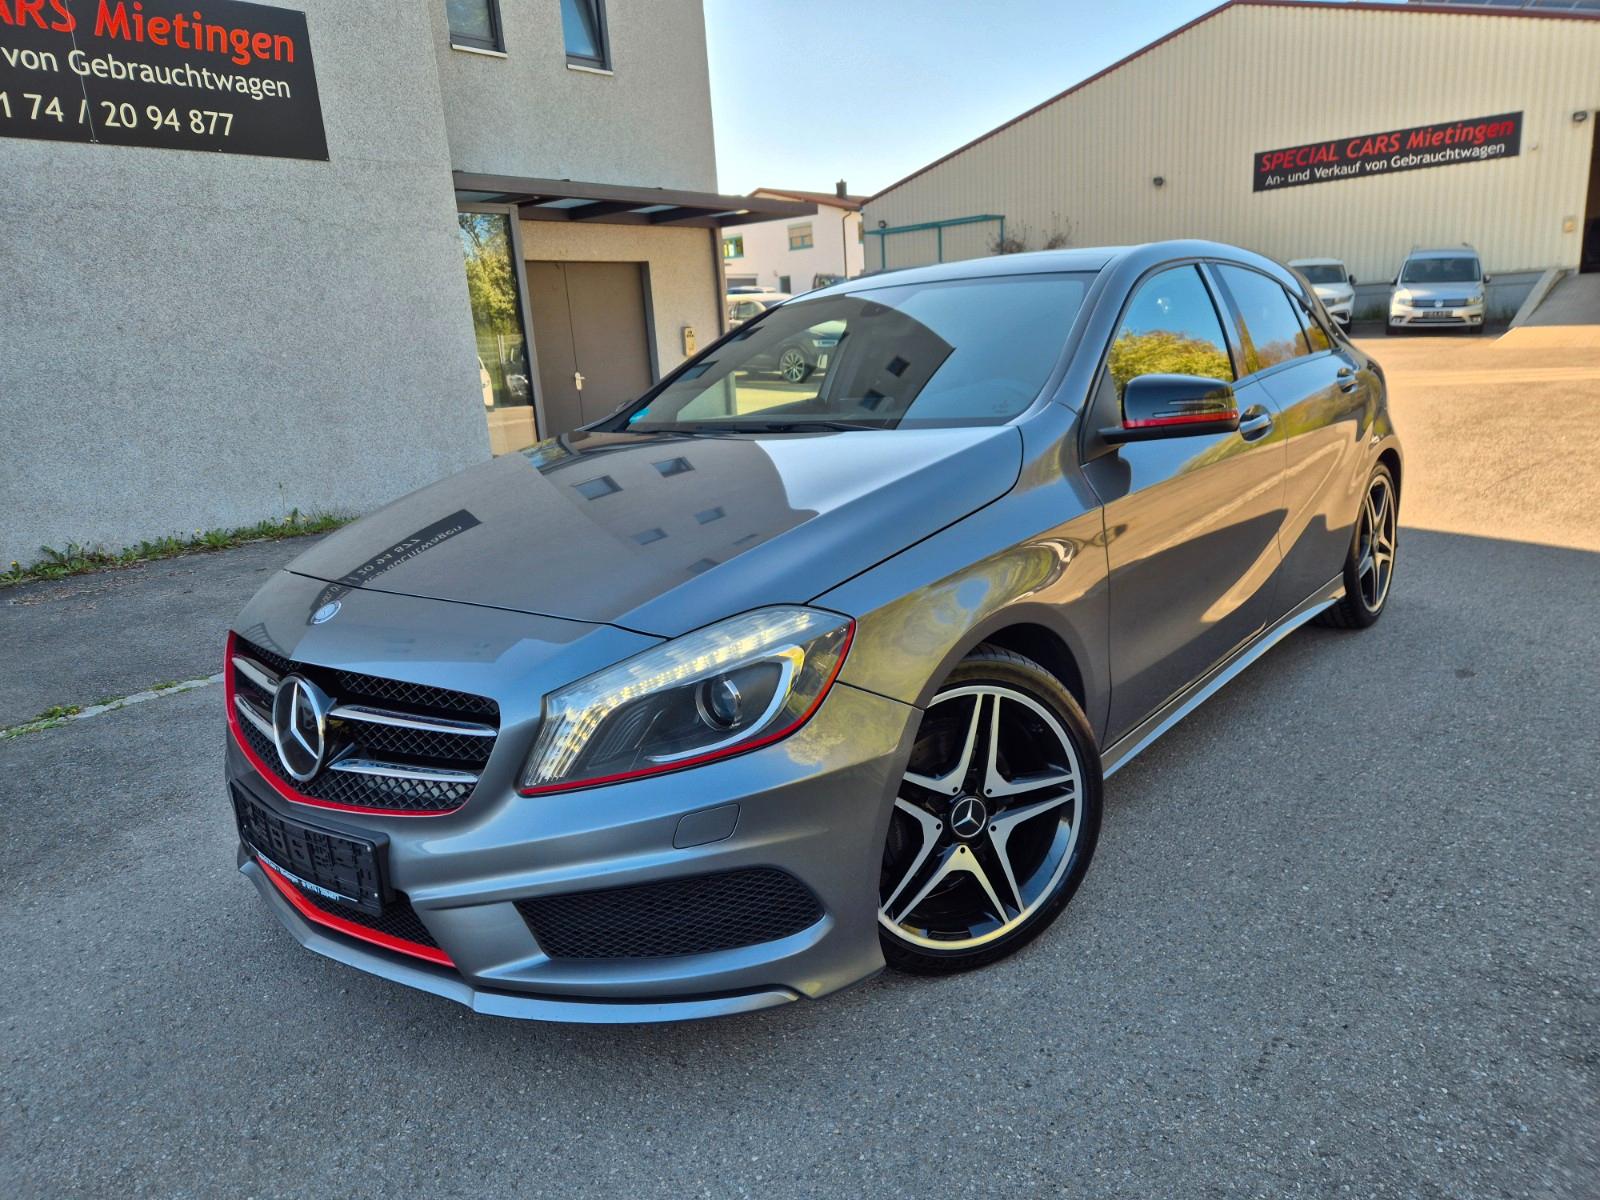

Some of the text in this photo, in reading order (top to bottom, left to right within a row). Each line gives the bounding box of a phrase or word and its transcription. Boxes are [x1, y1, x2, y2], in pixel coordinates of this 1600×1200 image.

[94, 1, 295, 66] Mietingen
[0, 46, 292, 100] von Gebrauchtwagen
[23, 93, 64, 122] 74
[100, 101, 138, 129] 20
[146, 105, 181, 132] 94
[190, 109, 235, 137] 877
[1260, 119, 1515, 173] SPECIAL CARS Mietingen
[1265, 141, 1505, 187] An- und Verkauf von Gebrauchtwagen
